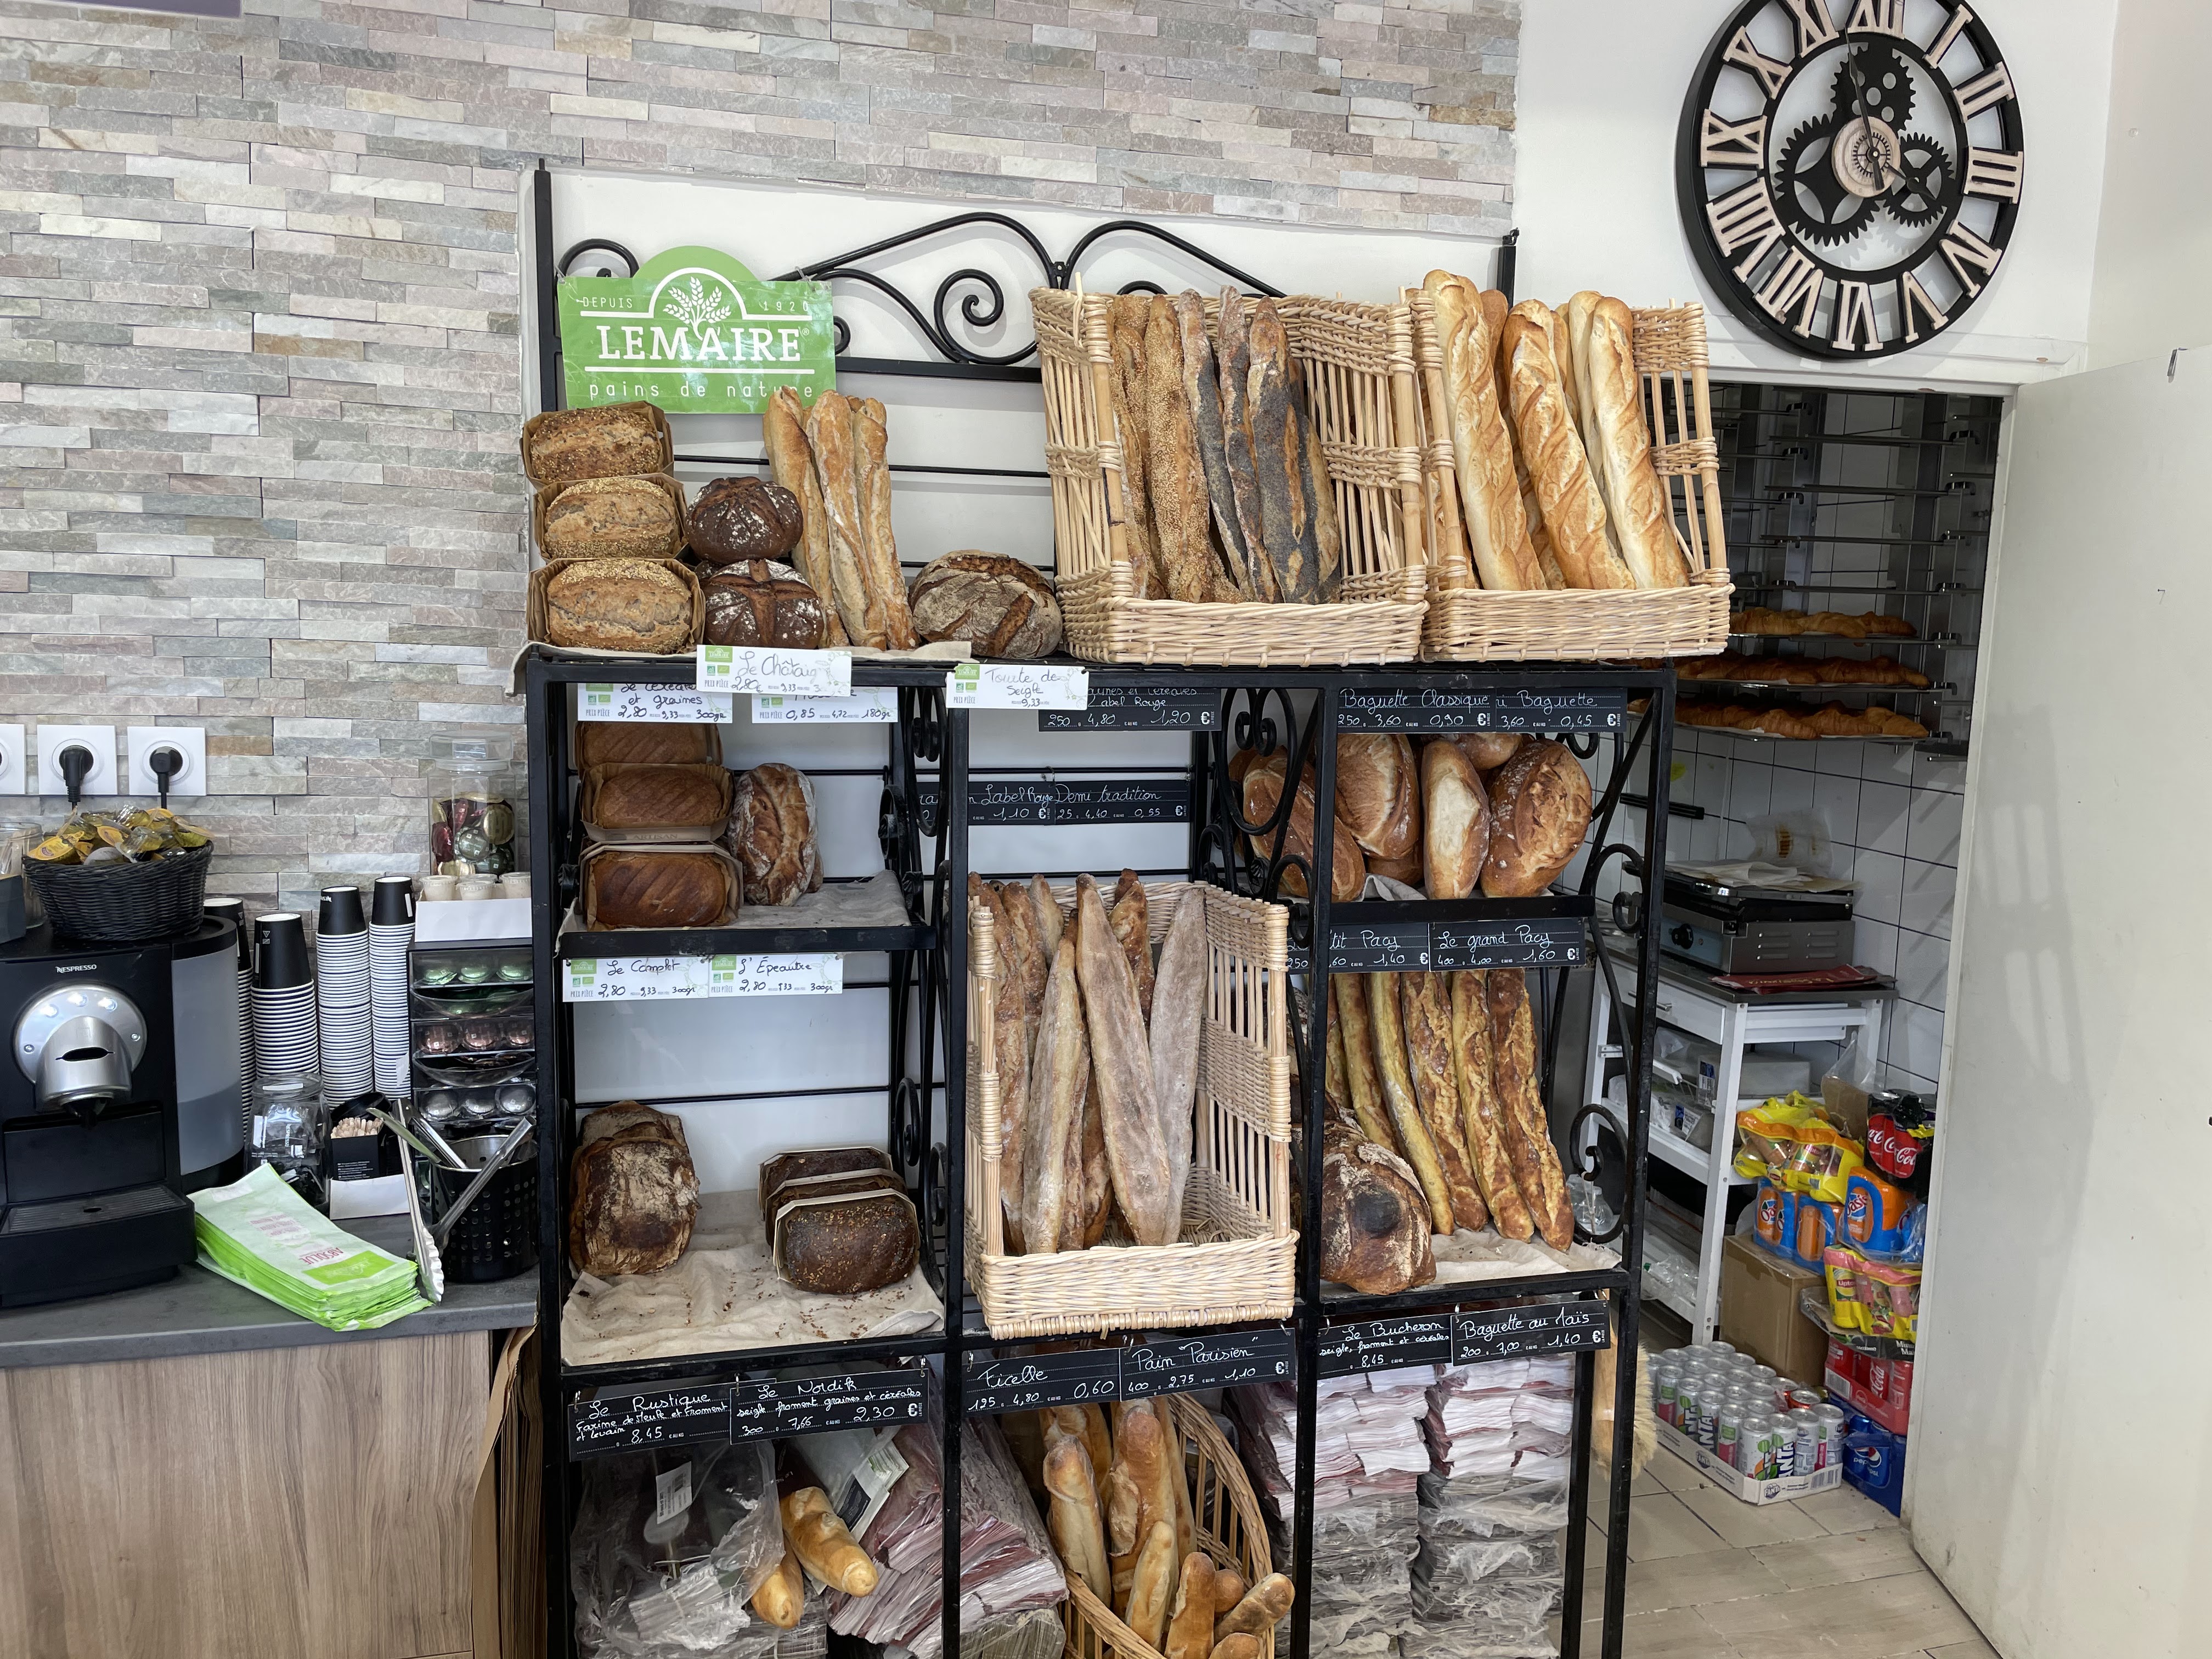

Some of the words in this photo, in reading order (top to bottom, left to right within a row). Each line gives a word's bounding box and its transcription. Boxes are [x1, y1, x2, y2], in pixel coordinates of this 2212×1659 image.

[1922, 4, 1973, 68] I
[1723, 26, 1793, 99] X
[1952, 61, 2015, 123] II
[1701, 109, 1767, 168] IX
[1963, 145, 2024, 204] III
[1706, 177, 1786, 283] VIII
[1940, 220, 2003, 298] IV
[1753, 245, 1824, 338] VII
[583, 297, 633, 309] DEPUIS
[763, 301, 808, 312] 1920
[1903, 271, 1949, 343] V
[1831, 279, 1883, 351] VI
[596, 325, 801, 362] LEMAIRE
[590, 381, 659, 400] pains
[681, 381, 706, 397] de
[737, 651, 758, 675] Le
[716, 679, 729, 688] PIÈCE
[1041, 669, 1060, 682] de
[629, 693, 641, 705] et
[653, 695, 703, 709] graines
[964, 696, 975, 704] PIÈCE
[1022, 698, 1041, 708] 9,33
[1135, 696, 1167, 711] Rouge
[1340, 689, 1410, 715] Baguette
[1421, 689, 1489, 714] Classique
[1517, 690, 1598, 715] Baguette
[597, 708, 610, 717] PIÈCE
[618, 706, 647, 719] 2,80
[662, 711, 679, 720] 9,33
[771, 710, 783, 719] PIÈCE
[786, 708, 815, 721] 0,85
[832, 710, 847, 719] 4,72
[1048, 714, 1070, 726] 250
[1087, 713, 1116, 727] 4,80
[1150, 709, 1191, 726] 1,20
[1200, 712, 1210, 725] €
[1338, 714, 1360, 725] 250
[1375, 714, 1401, 728] 3,60
[1430, 714, 1464, 728] 0,90
[1477, 713, 1486, 726] €
[1560, 715, 1592, 730] 0,45
[1607, 713, 1617, 726] €
[1501, 715, 1525, 730] 3,60
[981, 784, 1024, 805] Label
[1028, 787, 1056, 809] Rouge
[1055, 783, 1092, 803] Demi
[1097, 785, 1162, 803] tradition
[994, 807, 1029, 821] 1,10
[1038, 809, 1047, 819] €
[1085, 808, 1107, 820] 4,40
[1134, 808, 1160, 819] 0,55
[1175, 805, 1183, 816] €
[1438, 931, 1458, 949] Le
[1468, 931, 1509, 952] grand
[1373, 953, 1405, 967] 1,40
[1420, 952, 1428, 964] €
[1438, 954, 1454, 965] 400
[1471, 953, 1492, 965] 4,00
[1523, 949, 1555, 963] 1,60
[1567, 948, 1576, 960] €
[55, 964, 97, 973] NESPRESSO
[606, 960, 624, 975] Le
[631, 958, 680, 975] Complet
[599, 984, 626, 998] 2,80
[640, 986, 657, 997] 9,33
[740, 979, 766, 992] 2,80
[298, 1247, 344, 1265] ABSOLUE
[1342, 1326, 1361, 1341] Le
[1370, 1322, 1444, 1337] Bucheron
[1459, 1313, 1524, 1341] Baguette
[1528, 1318, 1548, 1329] au
[1357, 1338, 1394, 1354] froment
[1399, 1336, 1409, 1345] et
[1548, 1333, 1580, 1347] 1,40
[1592, 1330, 1601, 1343] €
[1460, 1346, 1481, 1358] 200
[1497, 1341, 1520, 1356] 7,00
[1132, 1348, 1176, 1371] Pain
[1362, 1354, 1384, 1368] 8,45
[977, 1363, 1048, 1388] Ficelle
[1224, 1368, 1256, 1381] 1,10
[1275, 1361, 1285, 1374] €
[758, 1385, 778, 1399] Le
[798, 1377, 856, 1395] Nordik
[1074, 1380, 1114, 1399] 0,60
[1128, 1382, 1149, 1392] 400
[1169, 1374, 1194, 1388] 2,75
[589, 1401, 610, 1419] Le
[632, 1393, 710, 1412] Rustique
[775, 1397, 818, 1417] froment
[824, 1395, 860, 1411] graines
[864, 1392, 876, 1401] et
[879, 1388, 921, 1400] céréales
[968, 1397, 996, 1410] 125
[1013, 1392, 1039, 1406] 4,80
[672, 1408, 682, 1418] et
[853, 1407, 895, 1422] 2,30
[907, 1403, 918, 1417] €
[631, 1426, 662, 1443] 8,45
[742, 1426, 763, 1435] 300
[788, 1416, 814, 1430] 7,66
[576, 1431, 586, 1442] et
